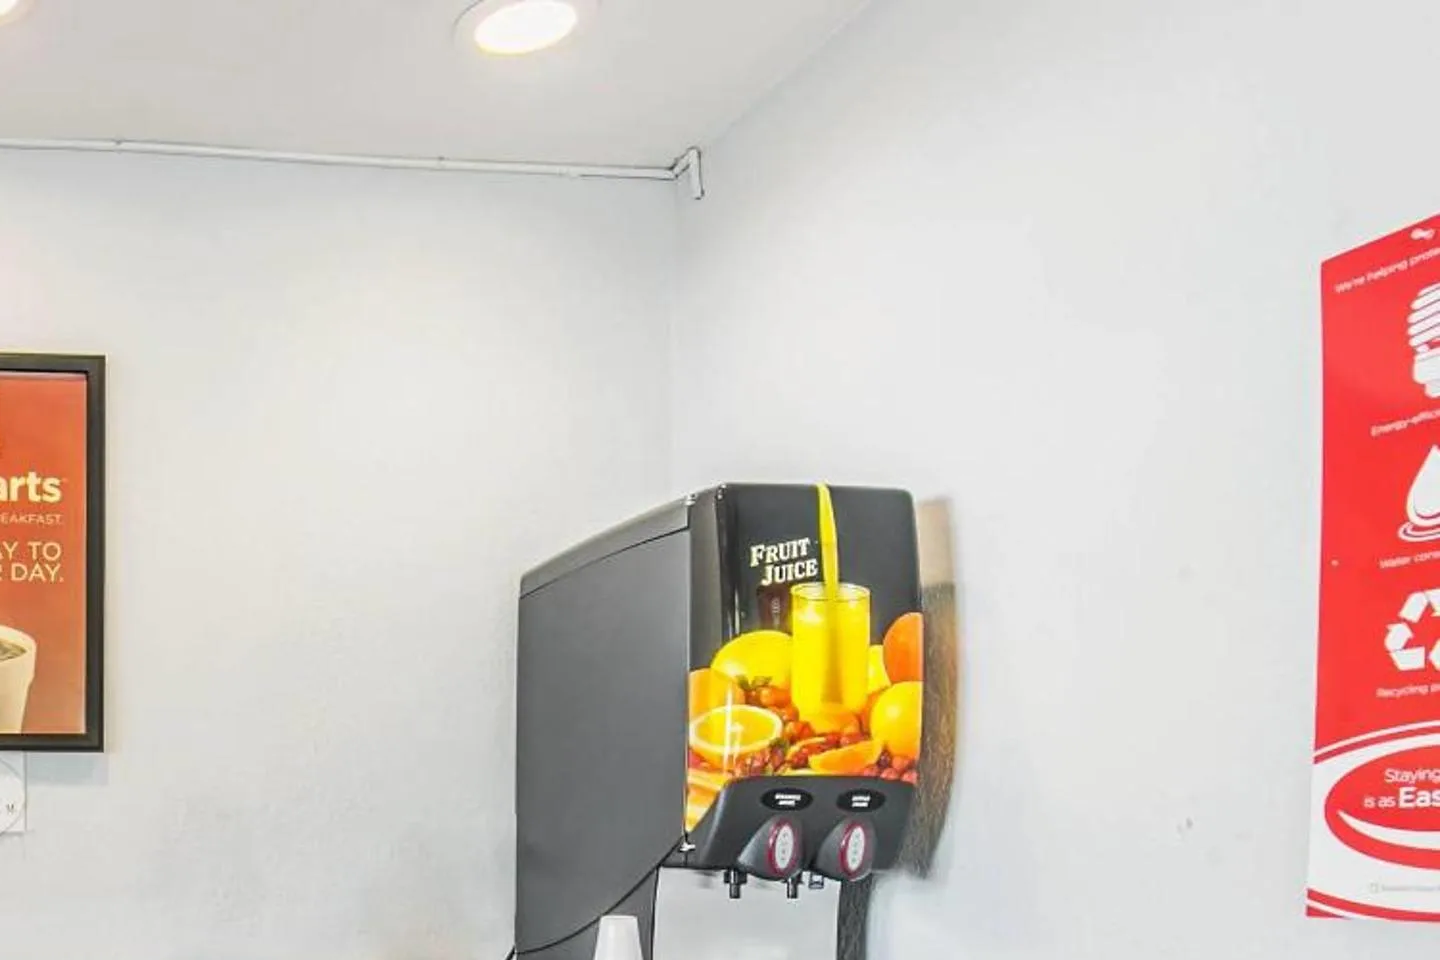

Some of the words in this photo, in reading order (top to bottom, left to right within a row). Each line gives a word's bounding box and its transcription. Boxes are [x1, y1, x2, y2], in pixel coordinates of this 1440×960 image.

[27, 541, 62, 561] TO
[750, 537, 811, 568] FRUIT
[11, 564, 64, 583] DAY.
[761, 559, 818, 586] JUICE
[1384, 767, 1440, 785] Staying
[1378, 796, 1396, 808] as
